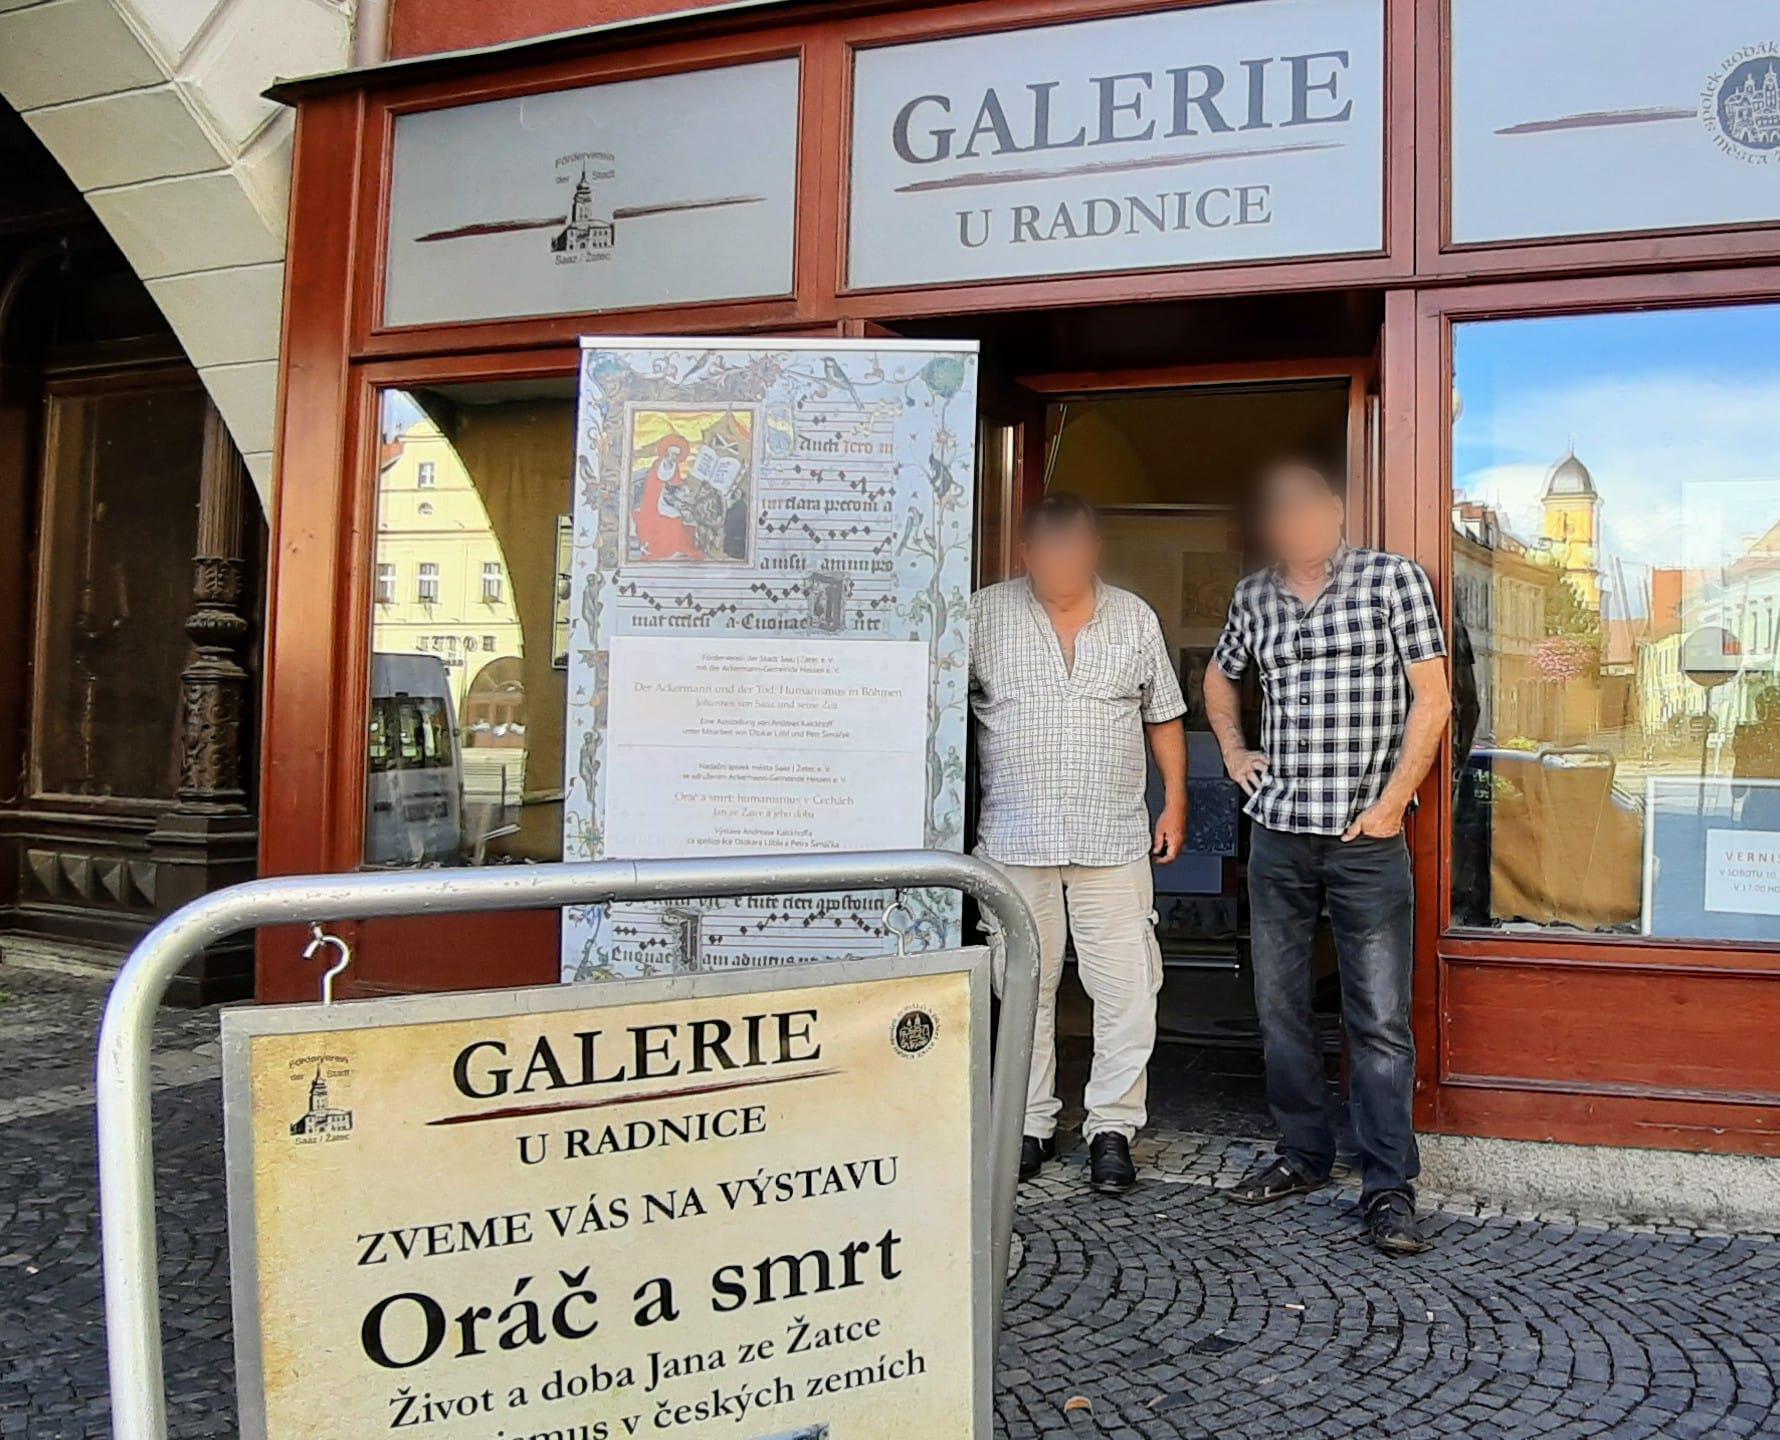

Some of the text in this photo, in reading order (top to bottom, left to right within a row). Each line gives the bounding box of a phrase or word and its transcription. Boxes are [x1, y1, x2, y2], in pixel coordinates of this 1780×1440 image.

[893, 50, 1352, 164] GALERIE
[956, 185, 1271, 248] U RADNICE
[633, 682, 652, 692] Der
[656, 682, 712, 694] Ackermann
[715, 684, 735, 694] und
[737, 684, 753, 694] der
[779, 685, 846, 696] Humanismus
[862, 686, 903, 697] Böhmen
[453, 1009, 822, 1099] GALERIE
[516, 1105, 767, 1165] U RADNICE
[357, 1156, 899, 1266] ZVEME VÁS NA VÝSTAVU
[361, 1229, 903, 1369] Oráč a smrt
[389, 1315, 882, 1429] Život a doba Jana ze Žatce
[620, 1414, 641, 1436] v
[653, 1376, 795, 1429] českých
[806, 1349, 927, 1398] zemích
